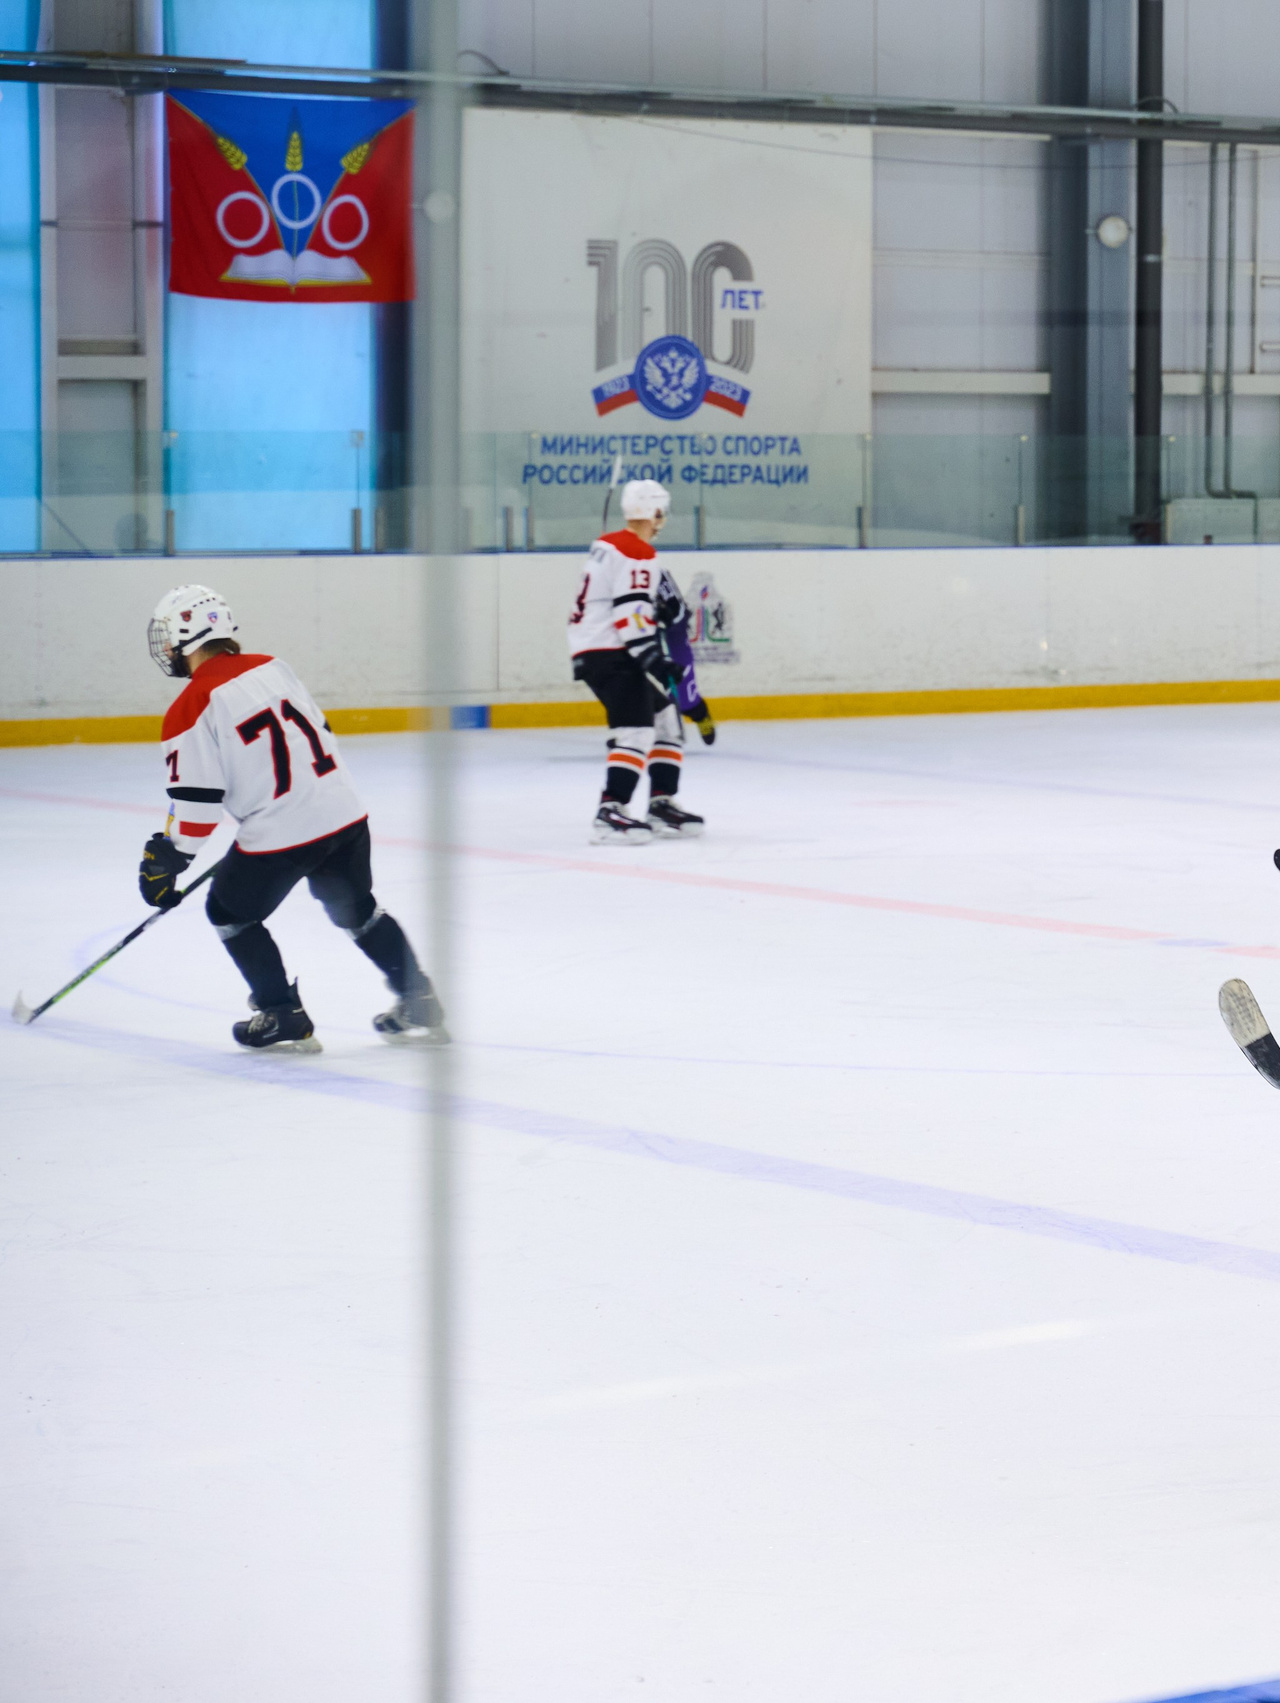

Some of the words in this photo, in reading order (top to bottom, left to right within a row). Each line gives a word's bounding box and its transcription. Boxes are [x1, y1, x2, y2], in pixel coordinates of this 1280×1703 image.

[720, 289, 764, 311] ЛЕТ
[540, 434, 717, 457] МИНИСТЕРСТВО
[722, 435, 802, 456] СПОРТА
[522, 459, 673, 485] РОССИЙКОЙ
[680, 464, 809, 487] ФЕДЕРАЦИИ
[630, 569, 651, 589] 13
[236, 698, 338, 800] 71
